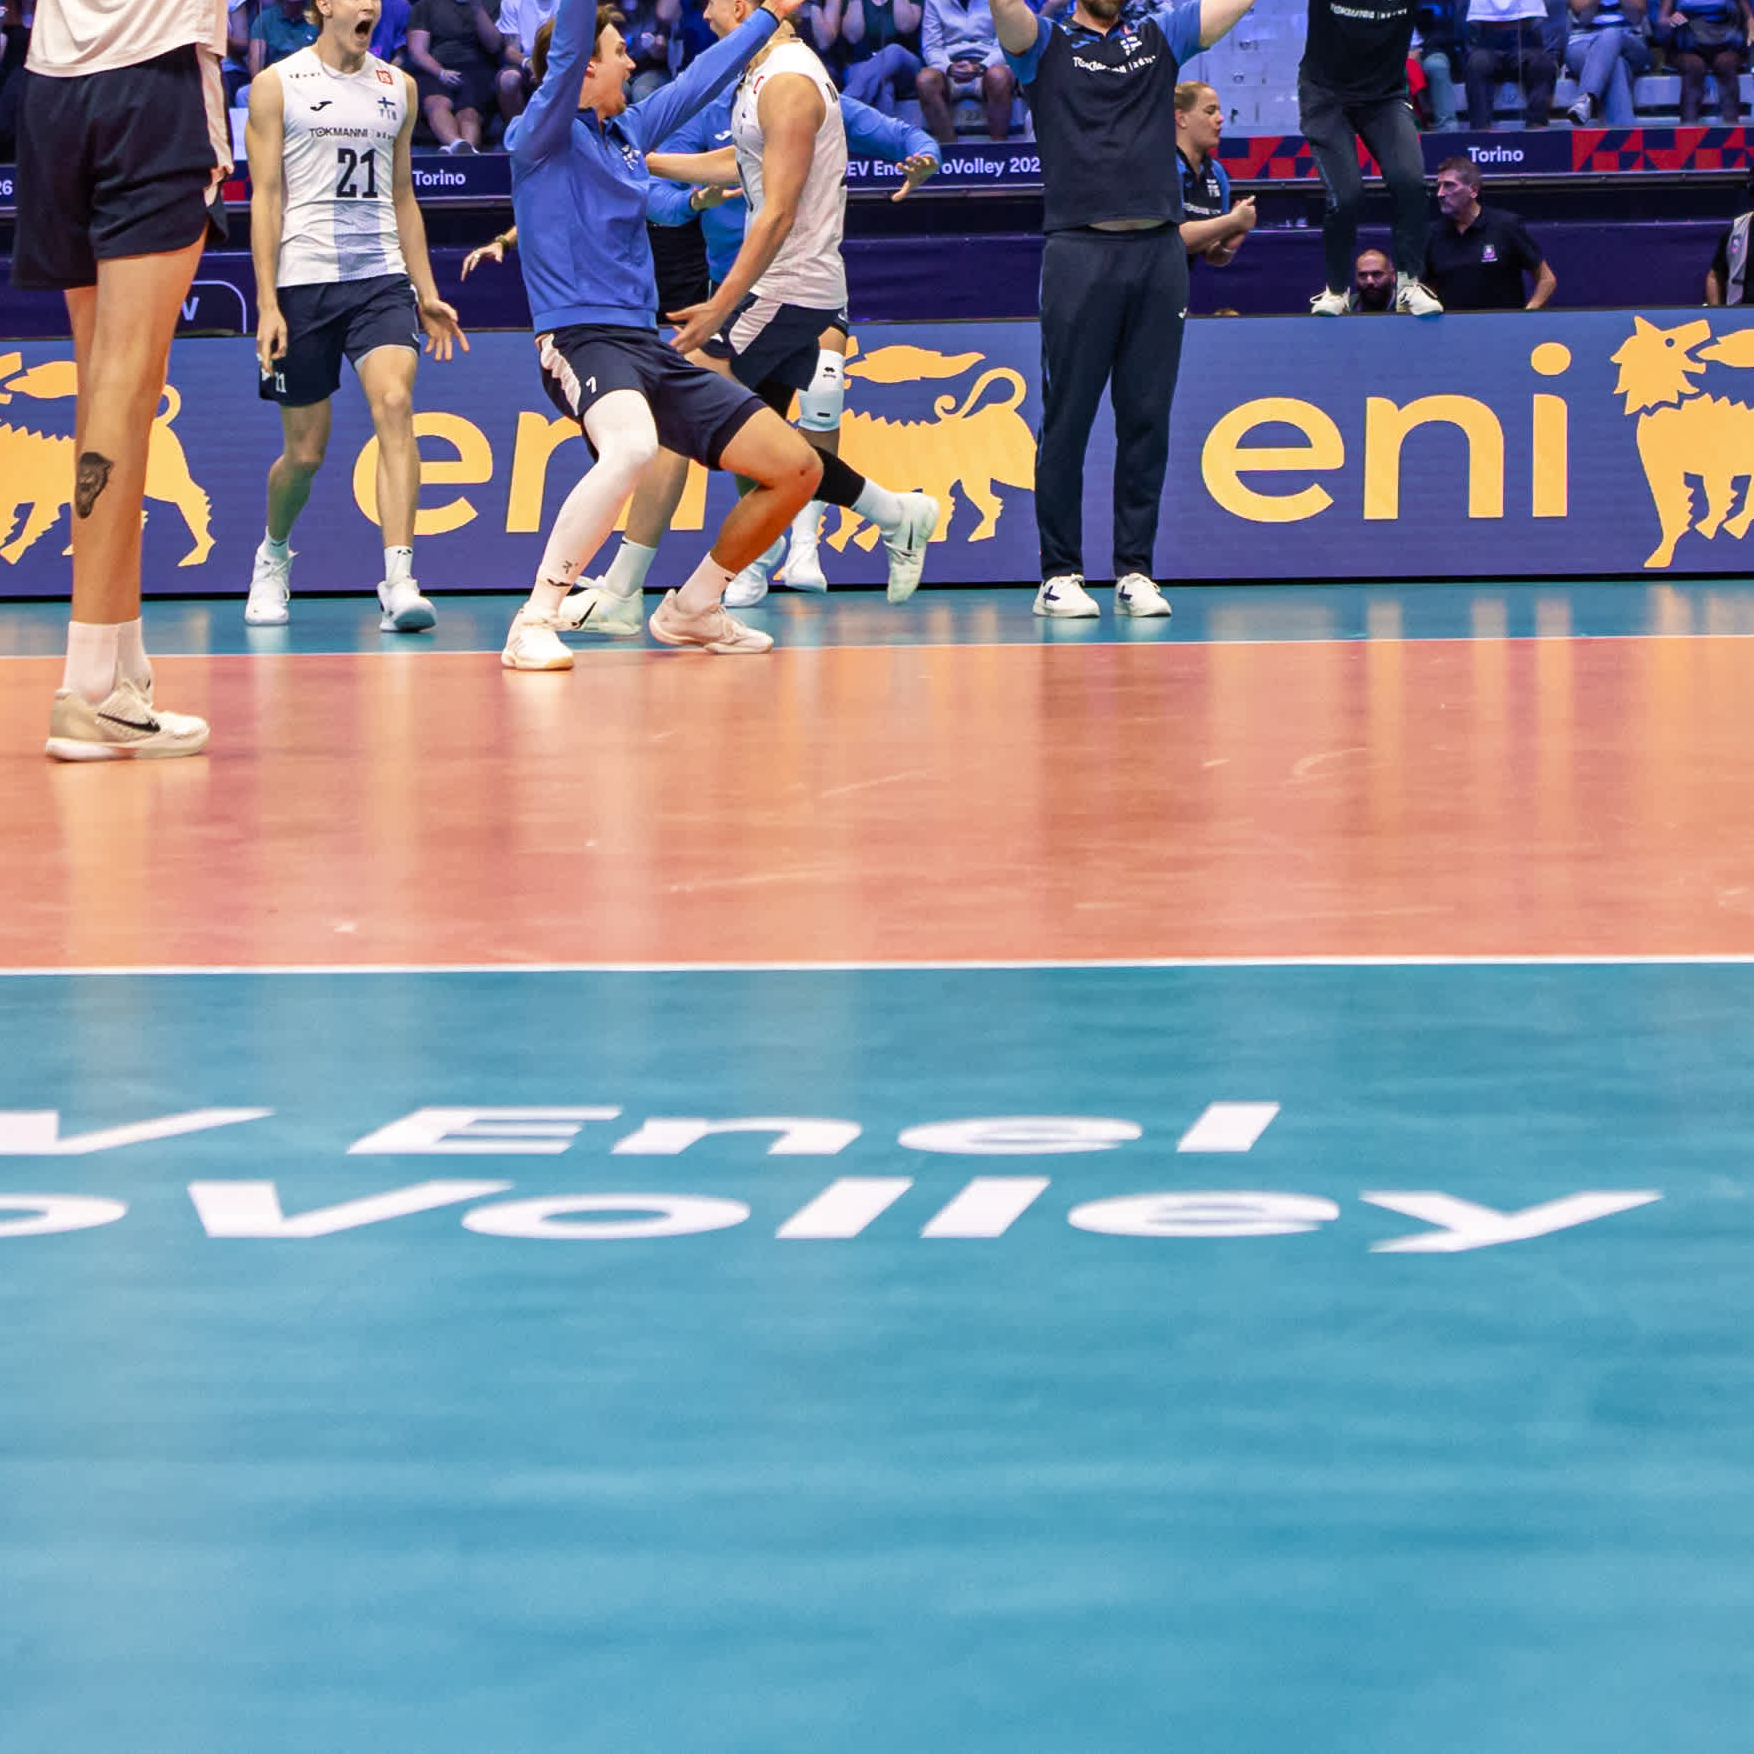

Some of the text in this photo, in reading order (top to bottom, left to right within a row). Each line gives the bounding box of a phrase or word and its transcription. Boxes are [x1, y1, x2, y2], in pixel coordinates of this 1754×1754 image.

[309, 127, 369, 139] TOKMANNI
[1468, 145, 1525, 164] Torino
[335, 147, 379, 199] 21
[847, 156, 1043, 177] EV Ene oVolley 202
[411, 168, 467, 188] Torino
[1200, 342, 1572, 524] eni
[345, 1100, 1282, 1156] Enel
